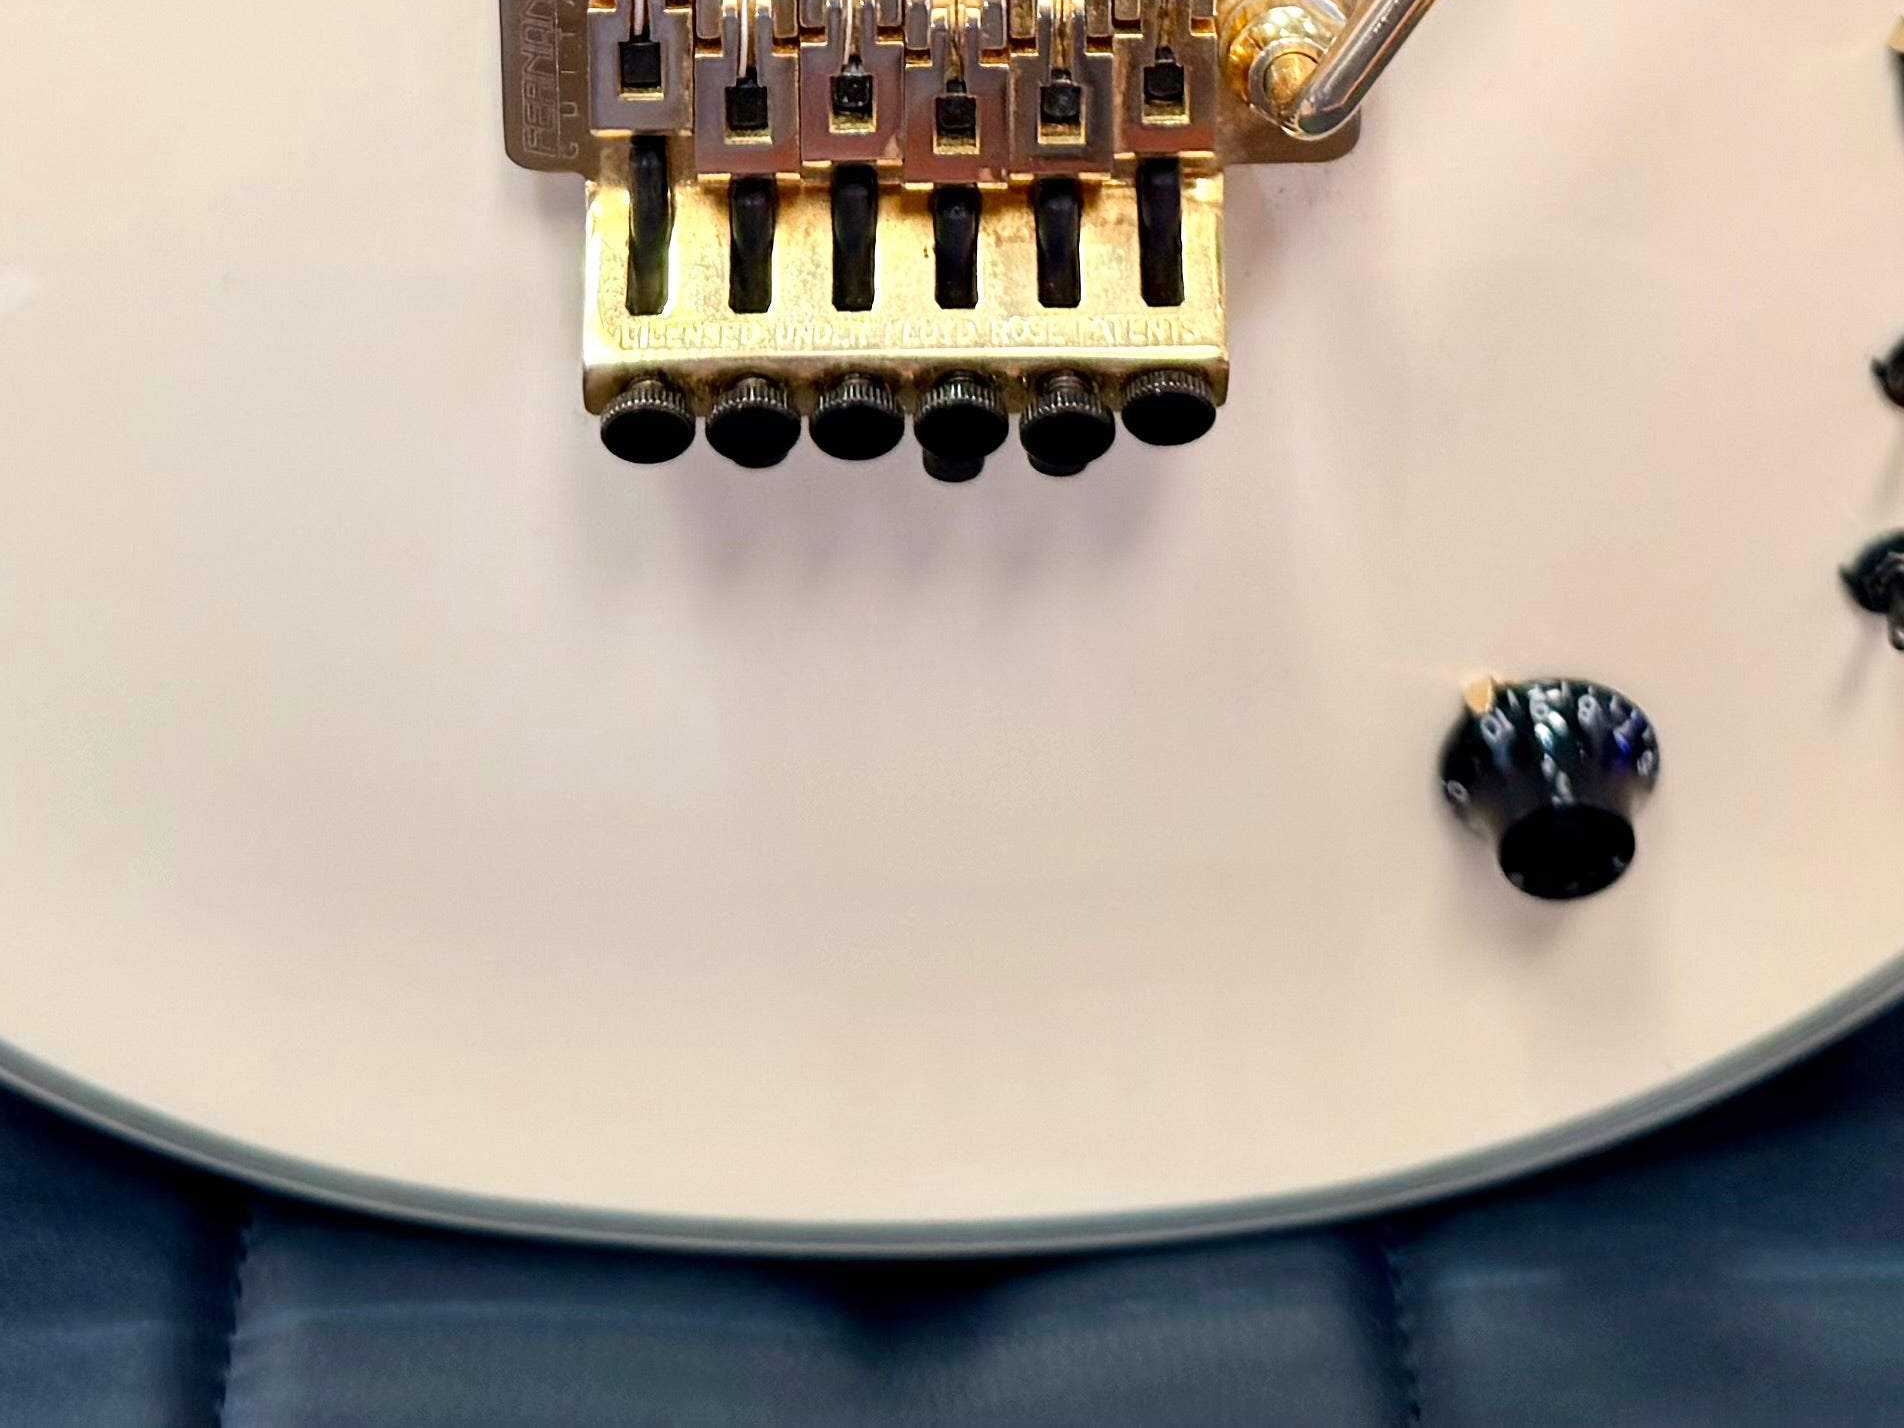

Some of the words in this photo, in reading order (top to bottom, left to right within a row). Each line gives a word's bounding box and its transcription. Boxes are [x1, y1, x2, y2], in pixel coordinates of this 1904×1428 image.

[618, 322, 760, 350] LICENSED
[775, 321, 869, 348] UNDER
[883, 319, 977, 347] FLOYD
[990, 318, 1067, 346] ROSE
[1078, 317, 1202, 346] PATENTS
